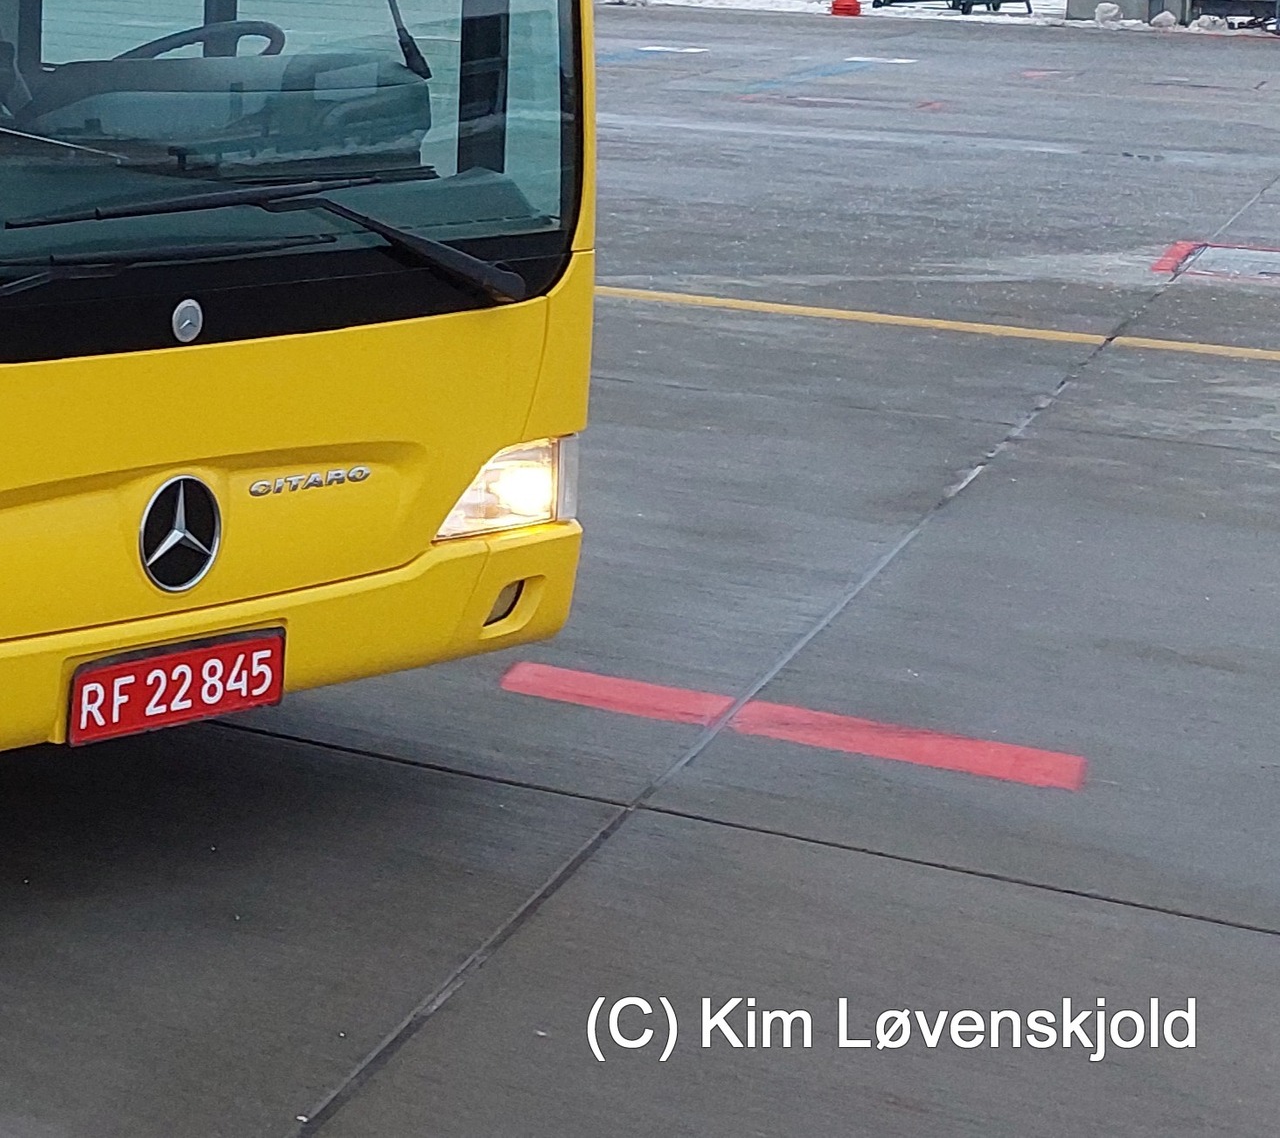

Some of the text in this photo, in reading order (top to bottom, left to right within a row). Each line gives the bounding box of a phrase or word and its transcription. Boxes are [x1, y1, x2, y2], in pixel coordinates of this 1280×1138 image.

[249, 465, 371, 497] CITARO
[79, 648, 273, 730] RF 22 845
